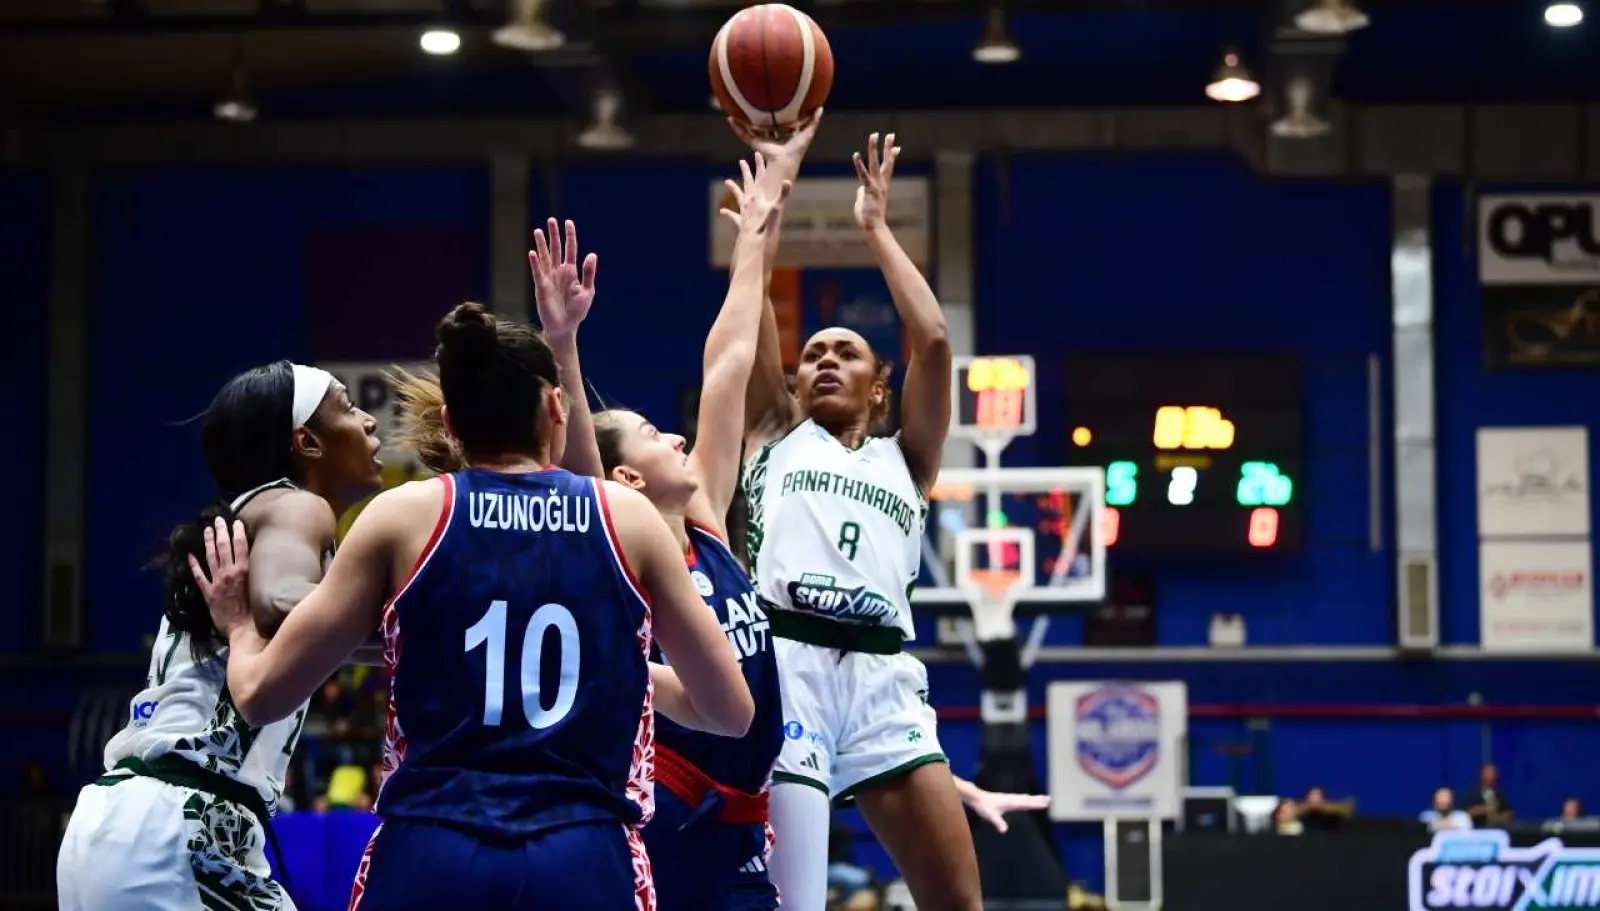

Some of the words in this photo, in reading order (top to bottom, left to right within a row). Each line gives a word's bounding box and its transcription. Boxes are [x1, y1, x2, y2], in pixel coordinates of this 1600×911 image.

[469, 487, 591, 533] UZUNOĞLU
[781, 469, 916, 537] PANATHINAIKOS
[837, 520, 861, 562] 8
[464, 600, 581, 730] 10
